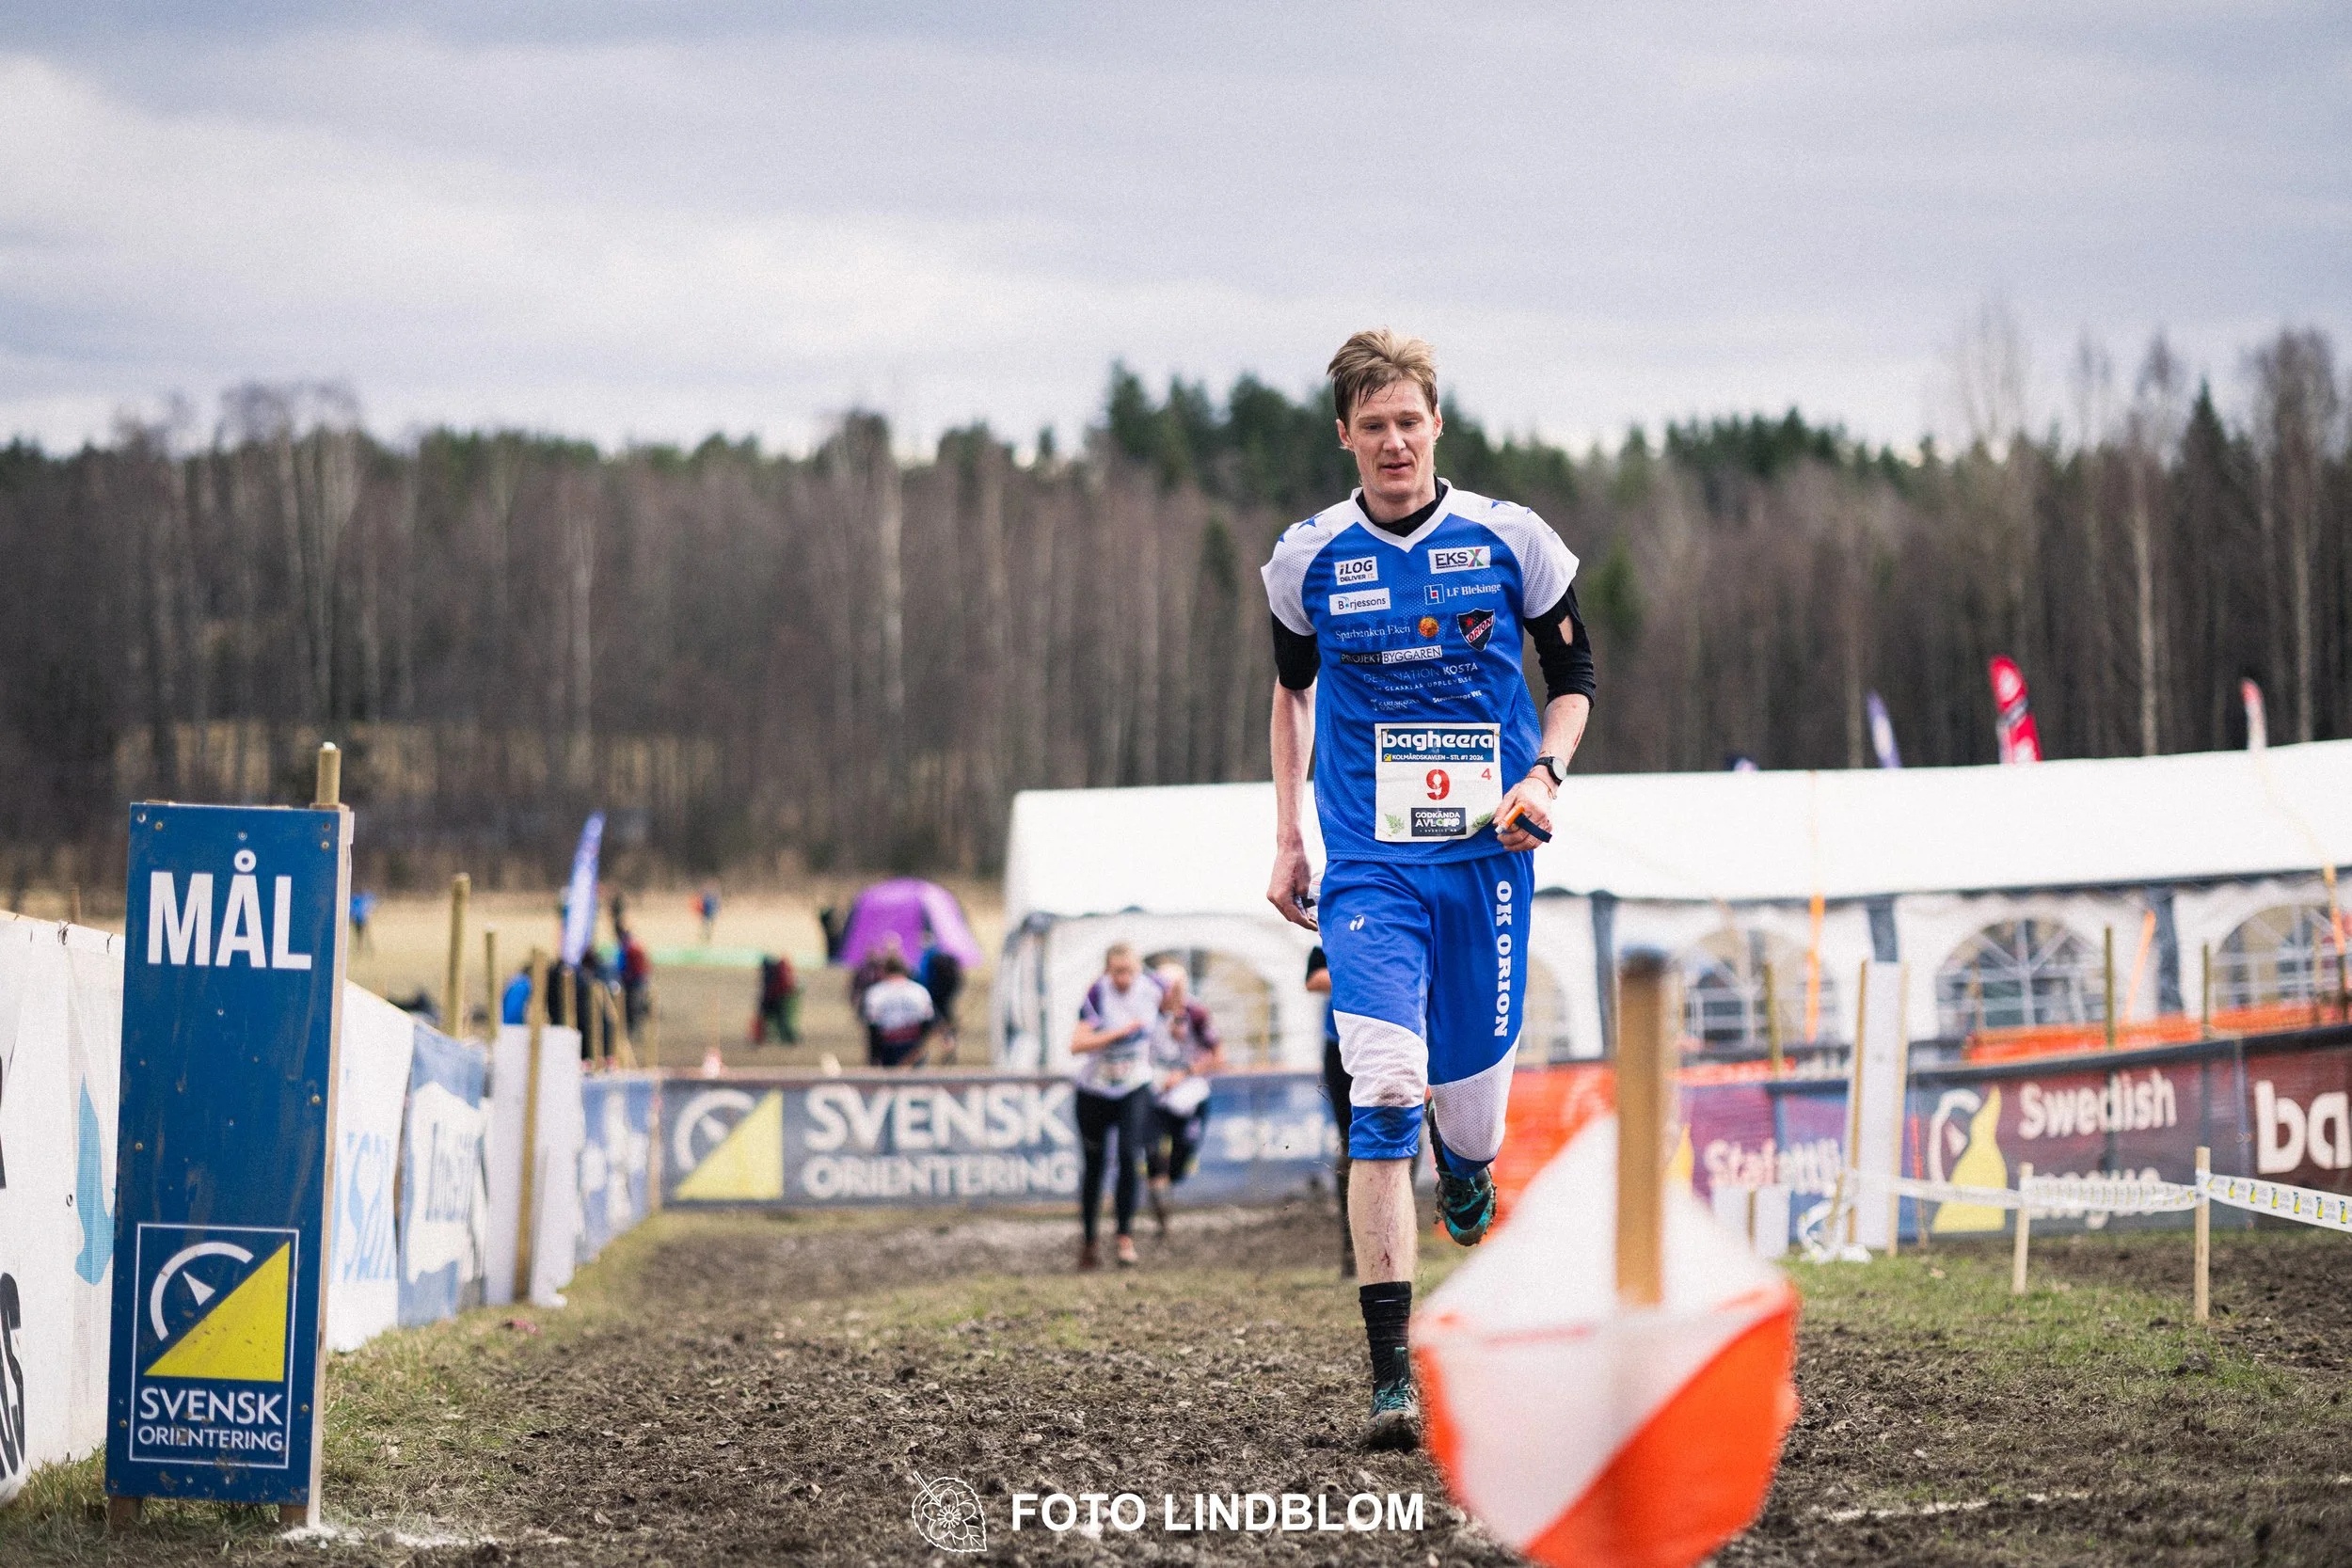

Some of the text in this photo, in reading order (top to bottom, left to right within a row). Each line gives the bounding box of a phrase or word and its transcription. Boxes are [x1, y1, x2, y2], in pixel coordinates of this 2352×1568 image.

[1340, 574, 1366, 582] DELIVER
[1446, 583, 1502, 597] LF Blekinge
[1468, 616, 1494, 641] ORION
[1442, 662, 1478, 675] KOSTA
[1382, 730, 1494, 752] bagheera
[1426, 768, 1451, 800] 9
[1481, 768, 1492, 780] 4
[1415, 810, 1460, 818] GODKÄNDA
[148, 849, 311, 970] MÅL
[1494, 880, 1512, 1037] OK ORION
[804, 1083, 1076, 1151] SVENSK
[2019, 1068, 2178, 1140] Swedish
[803, 1150, 1079, 1198] ORIENTERING
[139, 1387, 283, 1425] SVENSK
[137, 1425, 283, 1451] ORIENTERING
